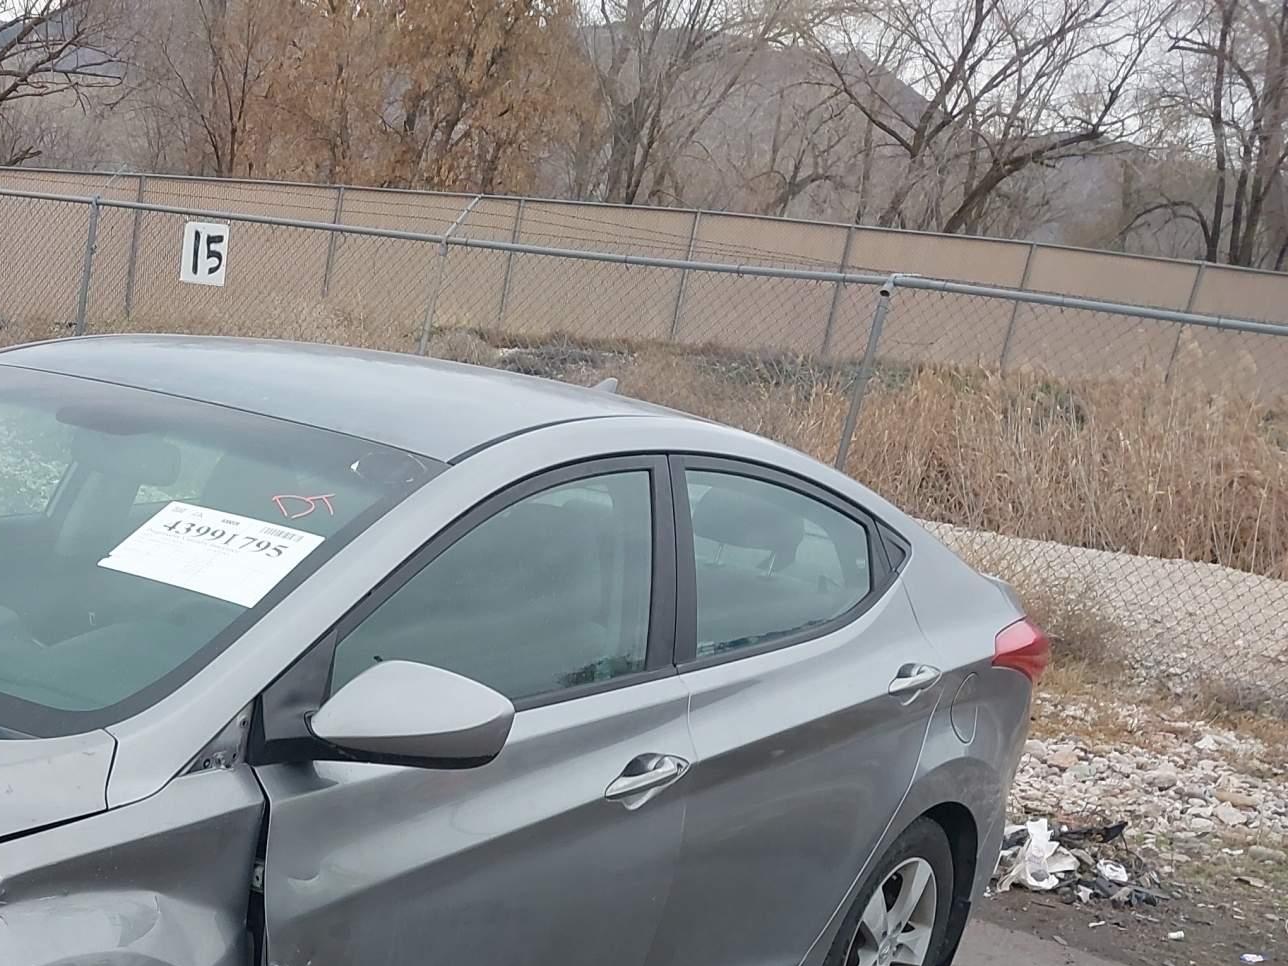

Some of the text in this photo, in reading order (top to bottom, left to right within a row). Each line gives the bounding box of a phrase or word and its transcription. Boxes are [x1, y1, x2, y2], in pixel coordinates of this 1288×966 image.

[192, 229, 225, 275] 15
[272, 493, 336, 519] DT
[163, 519, 289, 558] 43991795
